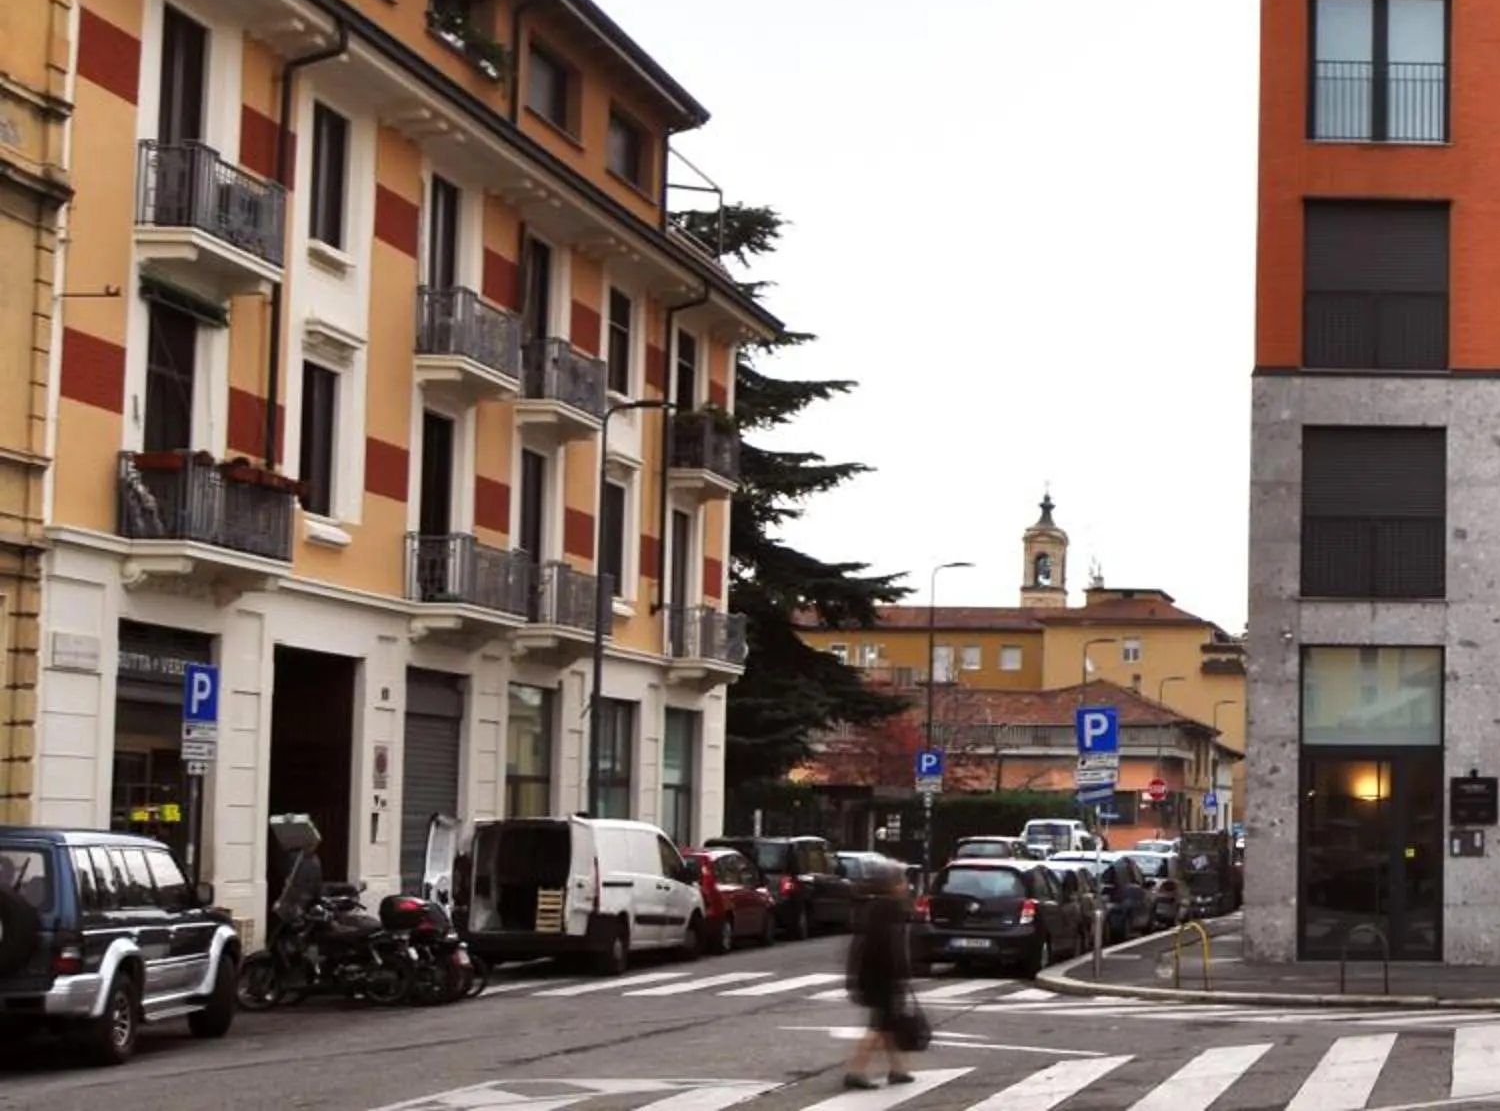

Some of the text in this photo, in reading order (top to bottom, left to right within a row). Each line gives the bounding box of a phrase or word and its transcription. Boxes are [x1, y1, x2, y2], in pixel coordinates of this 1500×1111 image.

[191, 672, 211, 714] P
[1083, 713, 1109, 748] P
[921, 753, 937, 773] P
